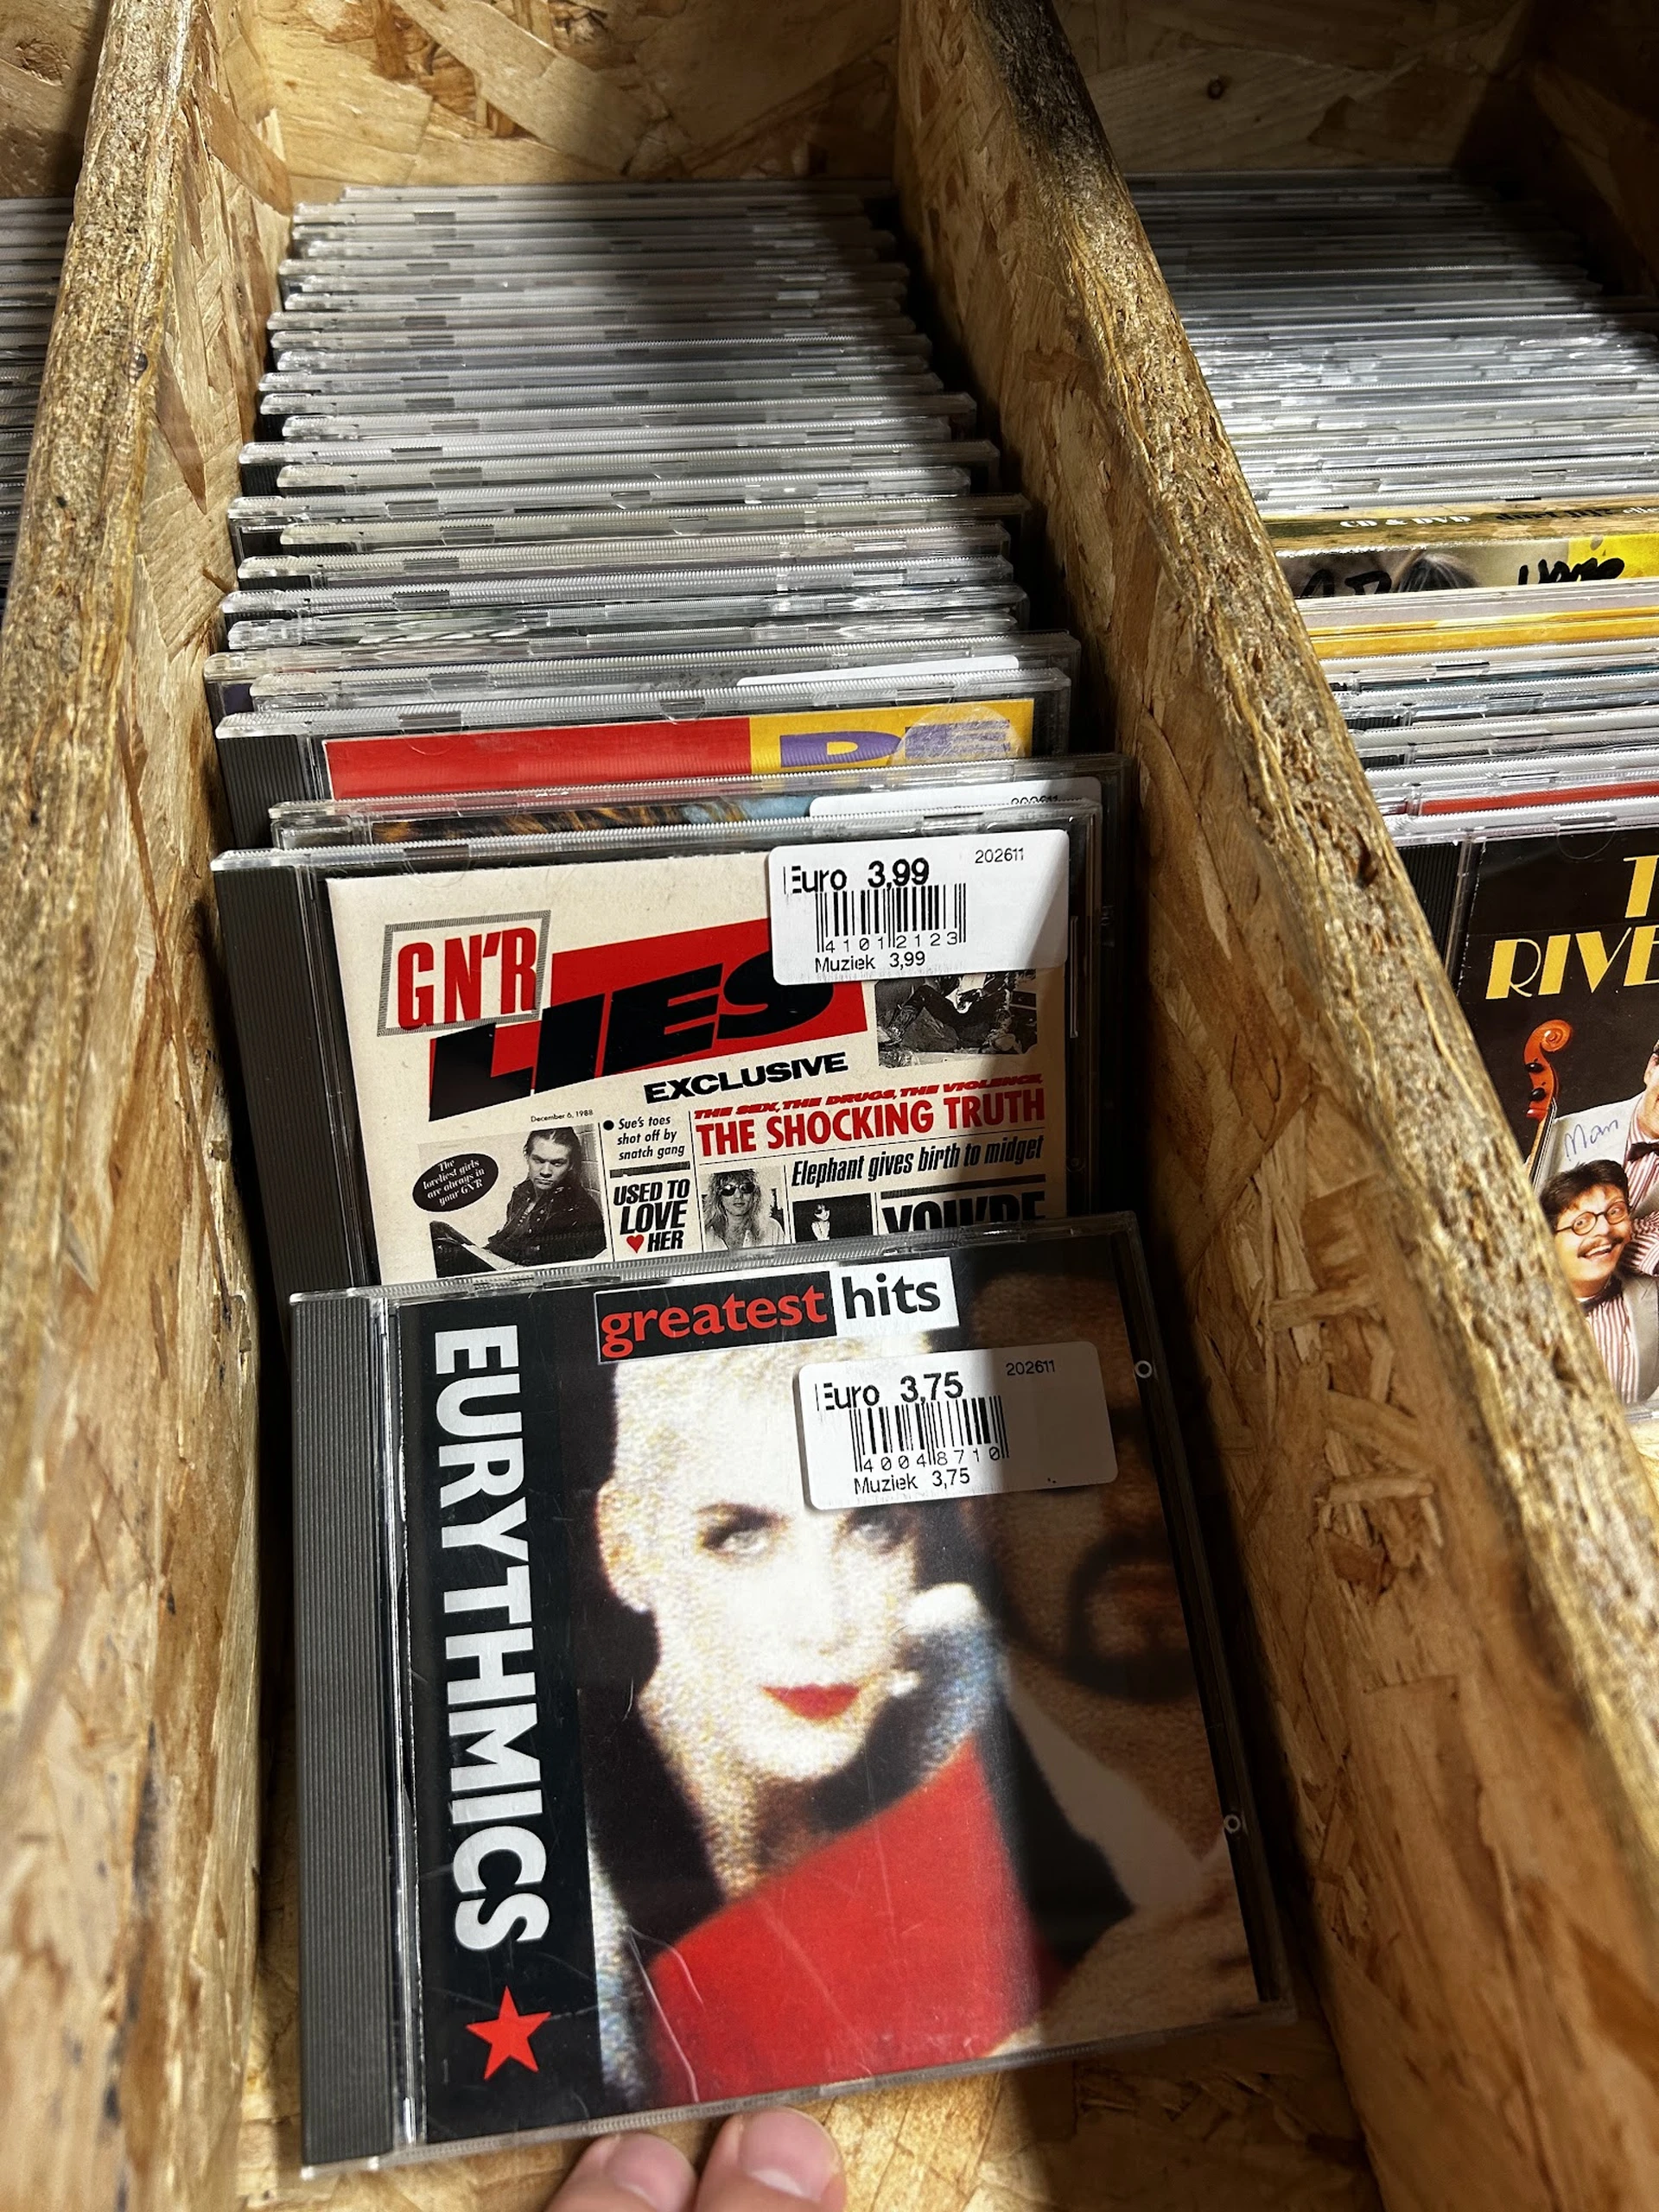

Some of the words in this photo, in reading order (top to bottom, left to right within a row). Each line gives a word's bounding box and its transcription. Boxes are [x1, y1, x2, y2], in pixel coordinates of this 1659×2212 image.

[975, 847, 1025, 864] 202611
[783, 866, 847, 894] Euro
[868, 857, 930, 891] 3,99
[815, 954, 876, 974] Muziek
[889, 951, 926, 970] 3,99
[397, 927, 537, 1031] GN'R
[429, 948, 835, 1122] LIES
[644, 1052, 849, 1104] EXCLUSIVE
[531, 1112, 565, 1122] December
[575, 1109, 594, 1117] 1988
[694, 1107, 733, 1120] THE
[782, 1097, 822, 1109] THE
[899, 1084, 940, 1097] THE
[617, 1133, 641, 1146] shot
[645, 1128, 660, 1142] off
[664, 1128, 677, 1143] by
[618, 1116, 645, 1130] Sue's
[648, 1116, 671, 1127] toes
[696, 1118, 757, 1157] THE
[766, 1100, 934, 1151] SHOCKING
[944, 1088, 1046, 1130] TRUTH
[438, 1160, 454, 1172] The
[619, 1147, 653, 1160] snatch
[658, 1145, 684, 1159] gang
[791, 1155, 864, 1189] Elephant
[868, 1151, 913, 1181] gives
[918, 1142, 958, 1173] birth
[963, 1140, 982, 1166] to
[985, 1135, 1044, 1166] midget
[423, 1168, 457, 1190] loveliest
[459, 1160, 480, 1175] girls
[427, 1187, 442, 1199] are
[443, 1174, 474, 1192] always
[475, 1168, 485, 1177] in
[438, 1190, 459, 1207] your
[613, 1181, 663, 1205] USED
[667, 1179, 690, 1199] TO
[620, 1199, 688, 1235] LOVE
[647, 1230, 683, 1252] HER
[601, 1284, 828, 1359] greatest
[842, 1272, 941, 1319] hits
[1006, 1359, 1056, 1376] 202611
[815, 1382, 880, 1411] Euro
[899, 1371, 963, 1404] 3,75
[854, 1472, 918, 1495] Muziek
[931, 1468, 970, 1490] 3,75
[435, 1325, 550, 1952] EURYTHMICS
